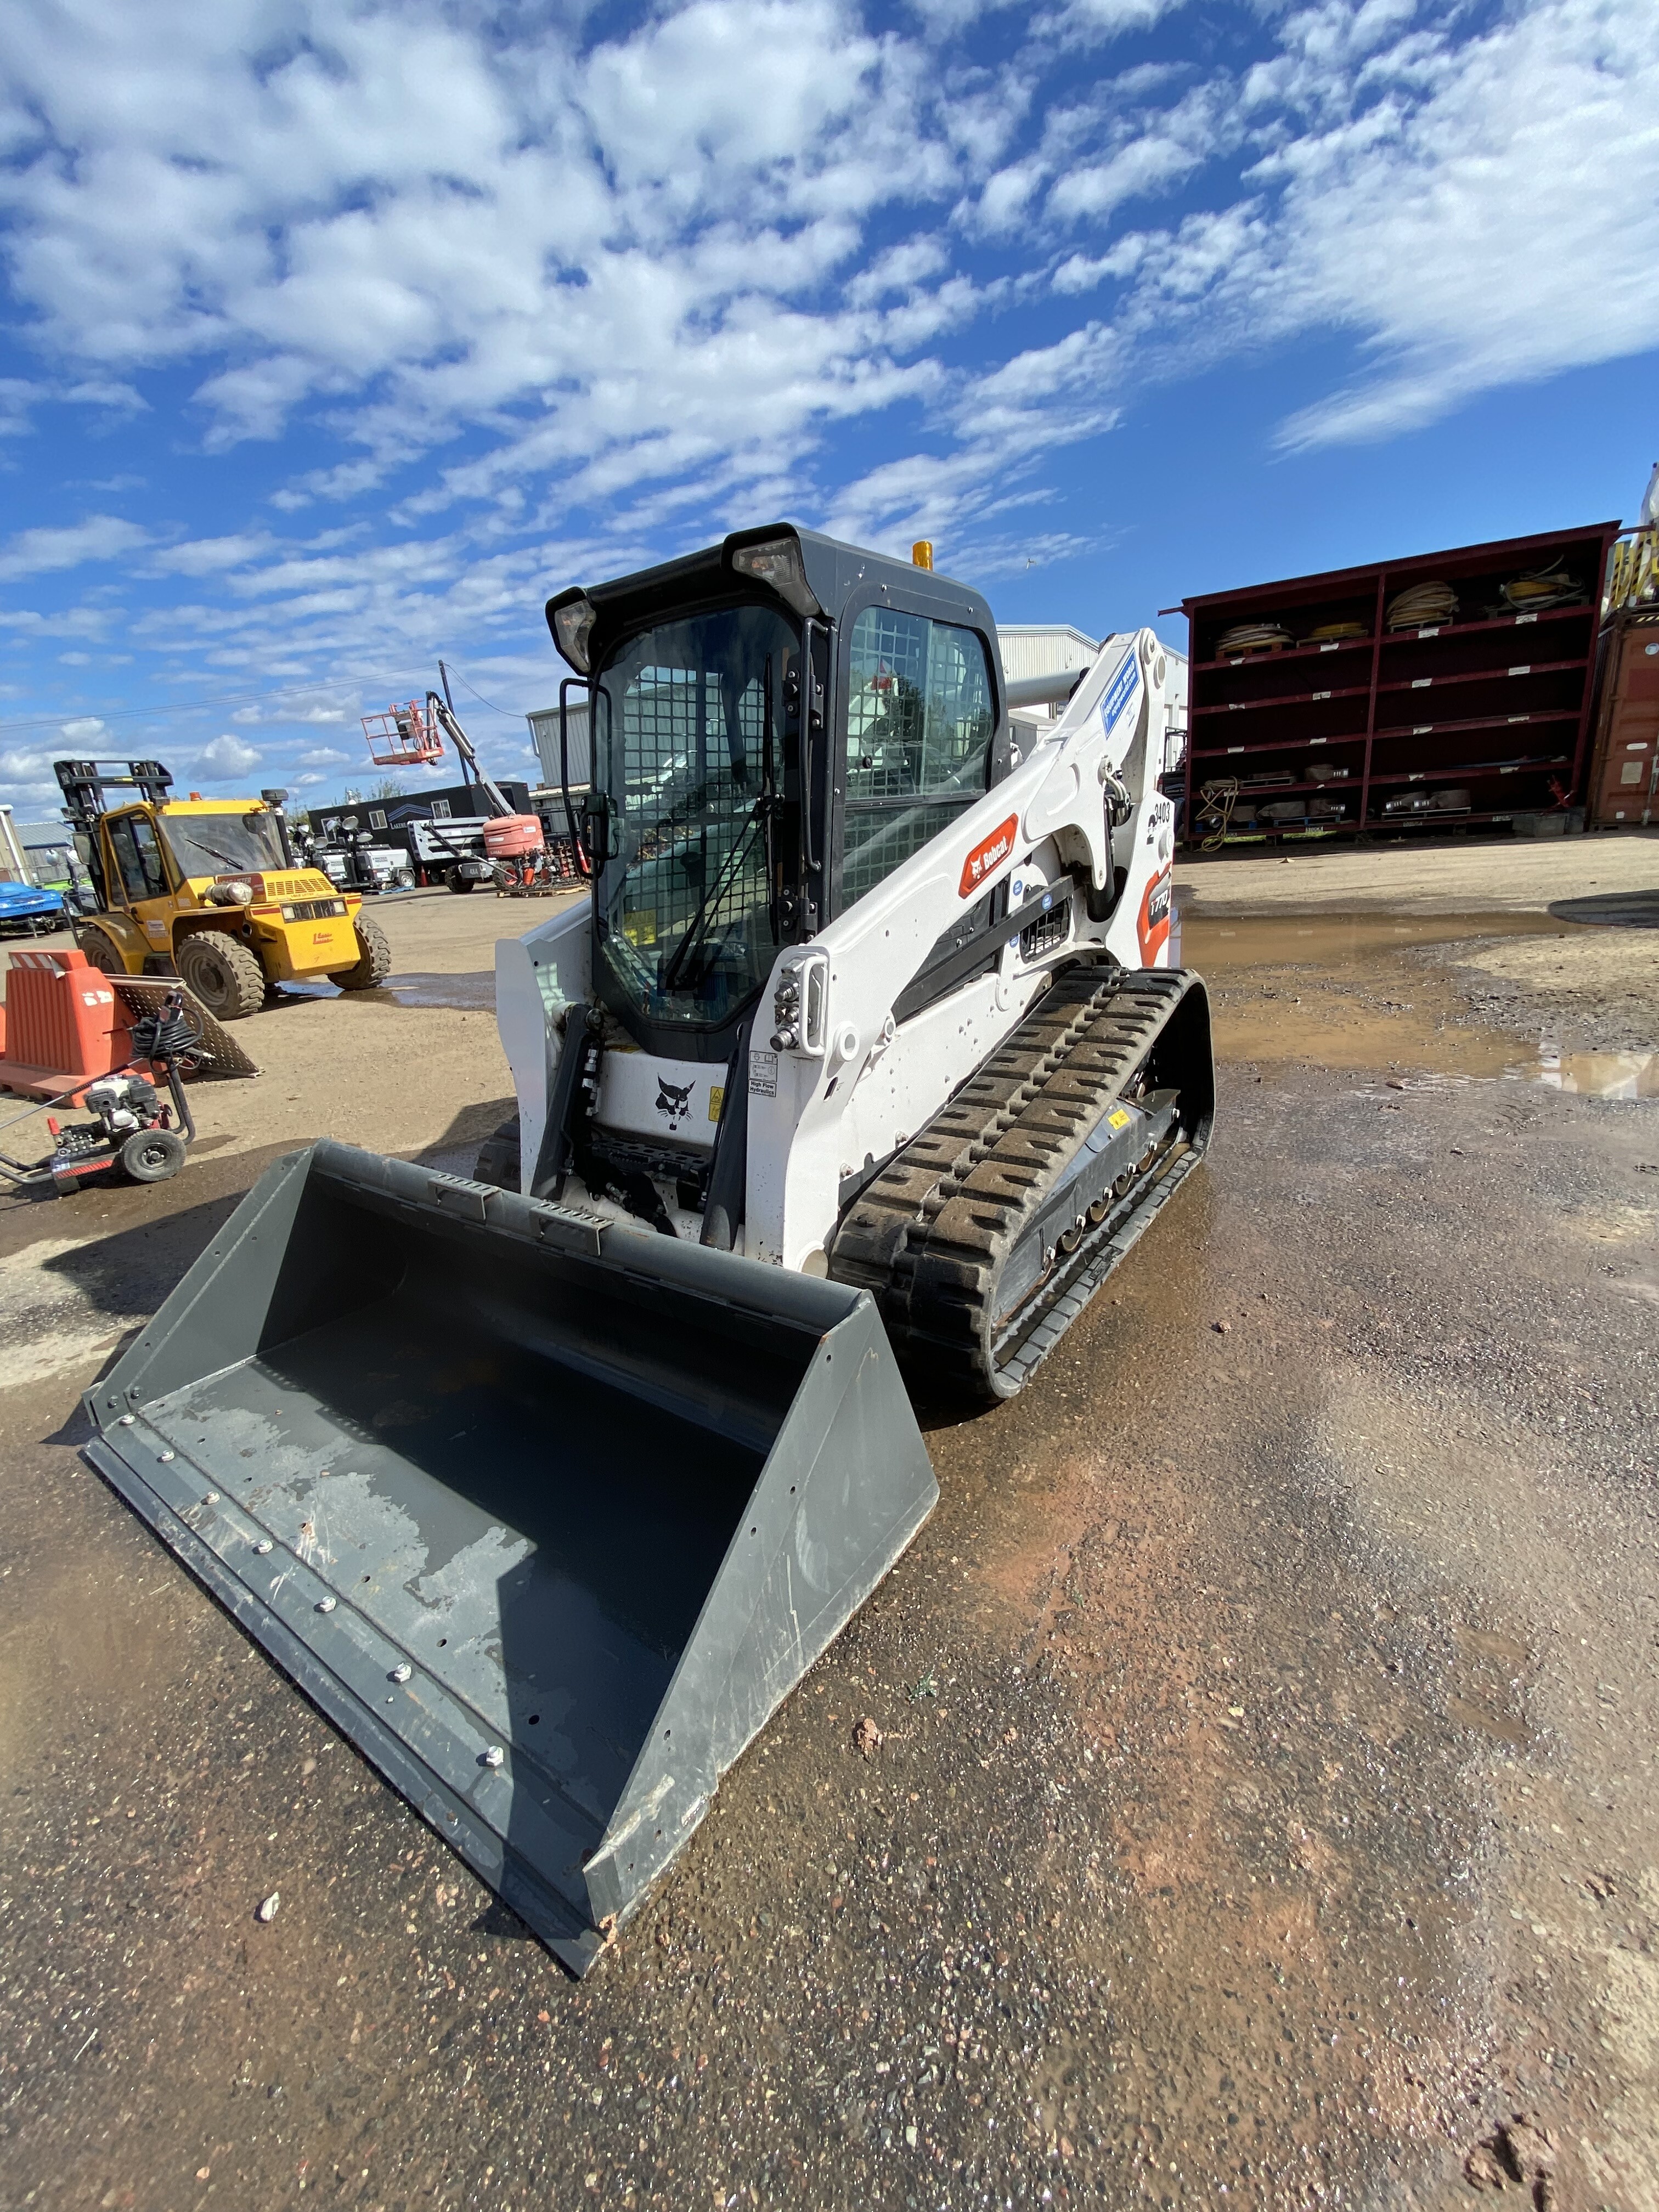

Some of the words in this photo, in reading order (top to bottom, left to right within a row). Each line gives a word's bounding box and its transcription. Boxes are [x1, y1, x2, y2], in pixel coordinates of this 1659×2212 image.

[1104, 680, 1123, 716] EQUIPMENT
[1122, 661, 1135, 683] WORLD
[1154, 802, 1170, 824] 3403
[983, 836, 1008, 870] Bobcat
[750, 1086, 774, 1095] Hydraulics
